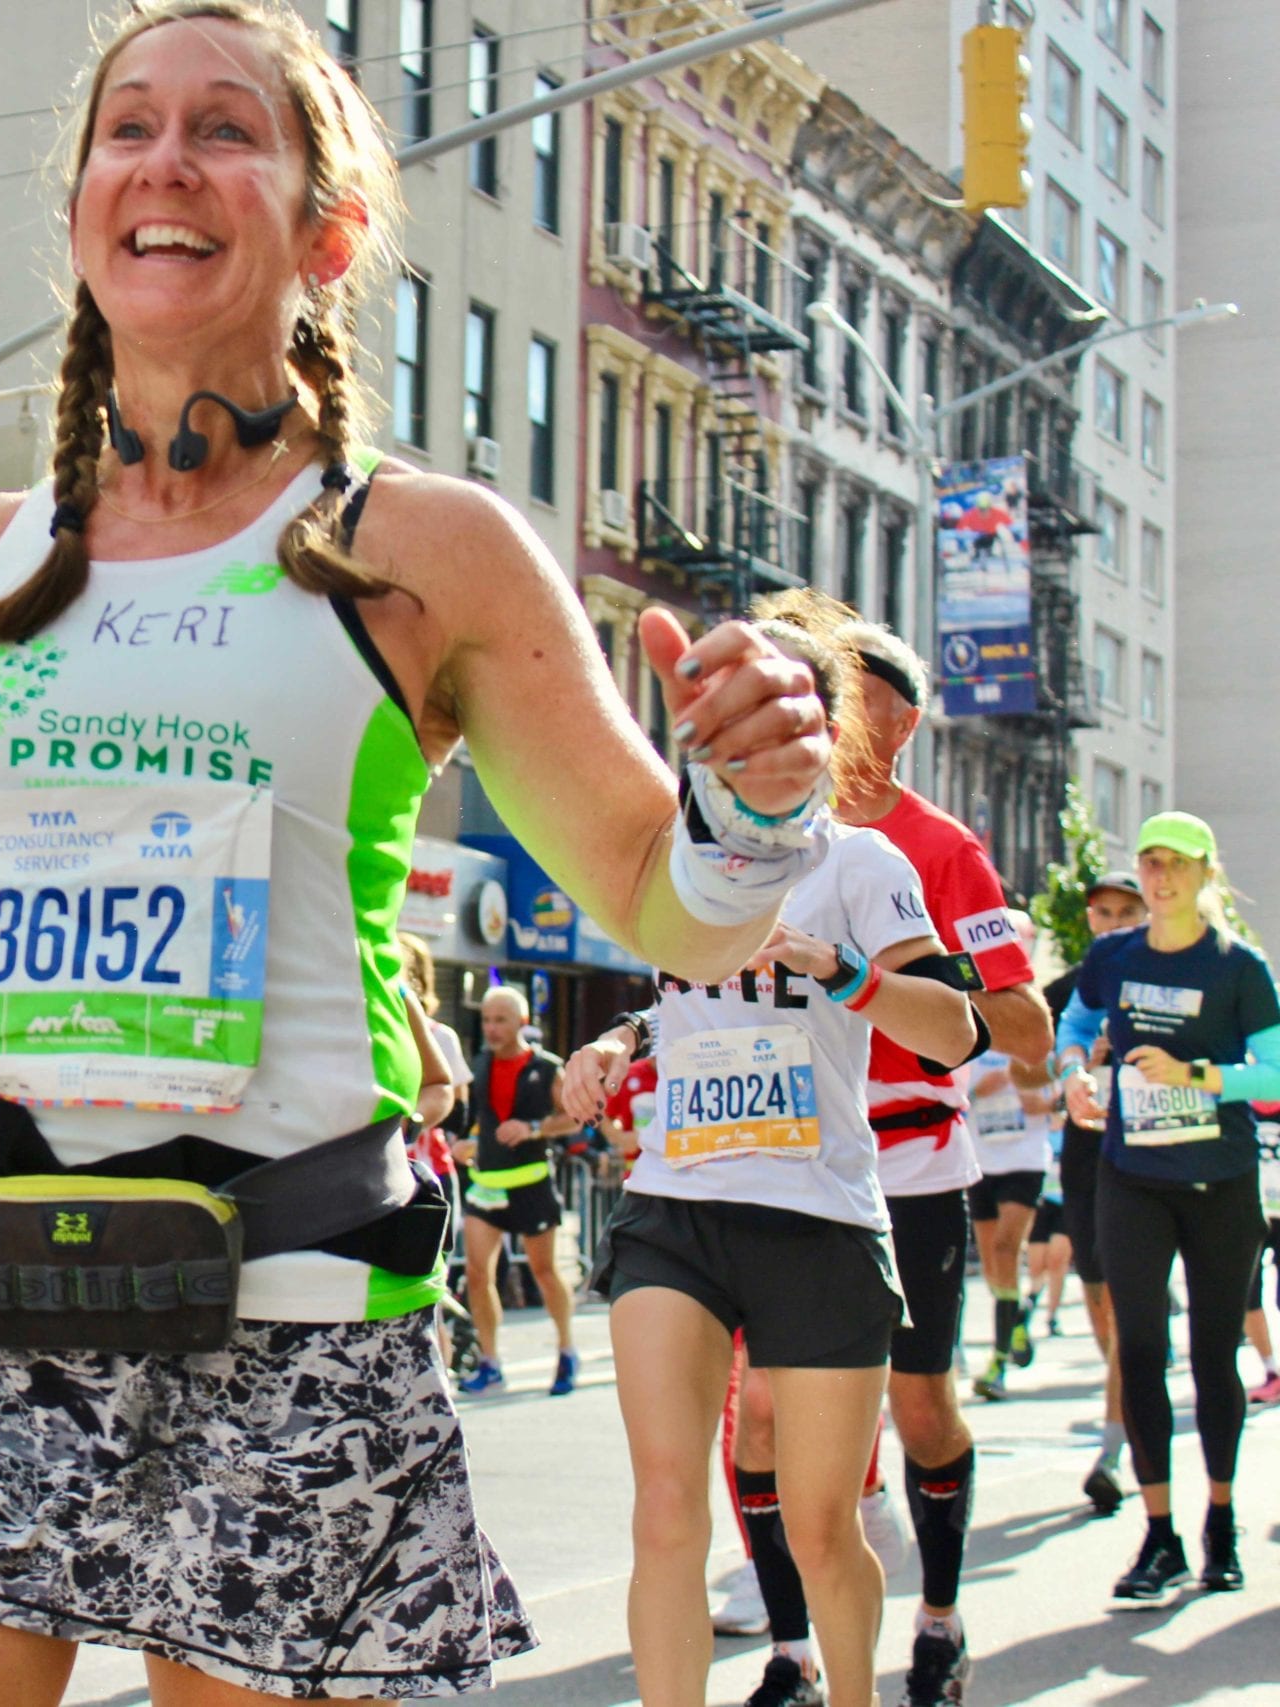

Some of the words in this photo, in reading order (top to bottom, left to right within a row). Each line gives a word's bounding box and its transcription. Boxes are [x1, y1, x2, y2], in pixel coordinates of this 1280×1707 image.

[92, 599, 234, 647] KERI
[38, 709, 146, 741] Sandy
[157, 714, 251, 749] Hook
[10, 738, 273, 787] PROMISE
[29, 811, 77, 828] TATA
[14, 852, 91, 872] SERVICES
[140, 844, 193, 859] TATA
[193, 1018, 216, 1047] F
[699, 1040, 721, 1049] TATA
[752, 1053, 777, 1063] TATA
[670, 1083, 682, 1126] 2019
[688, 1072, 787, 1123] 43024
